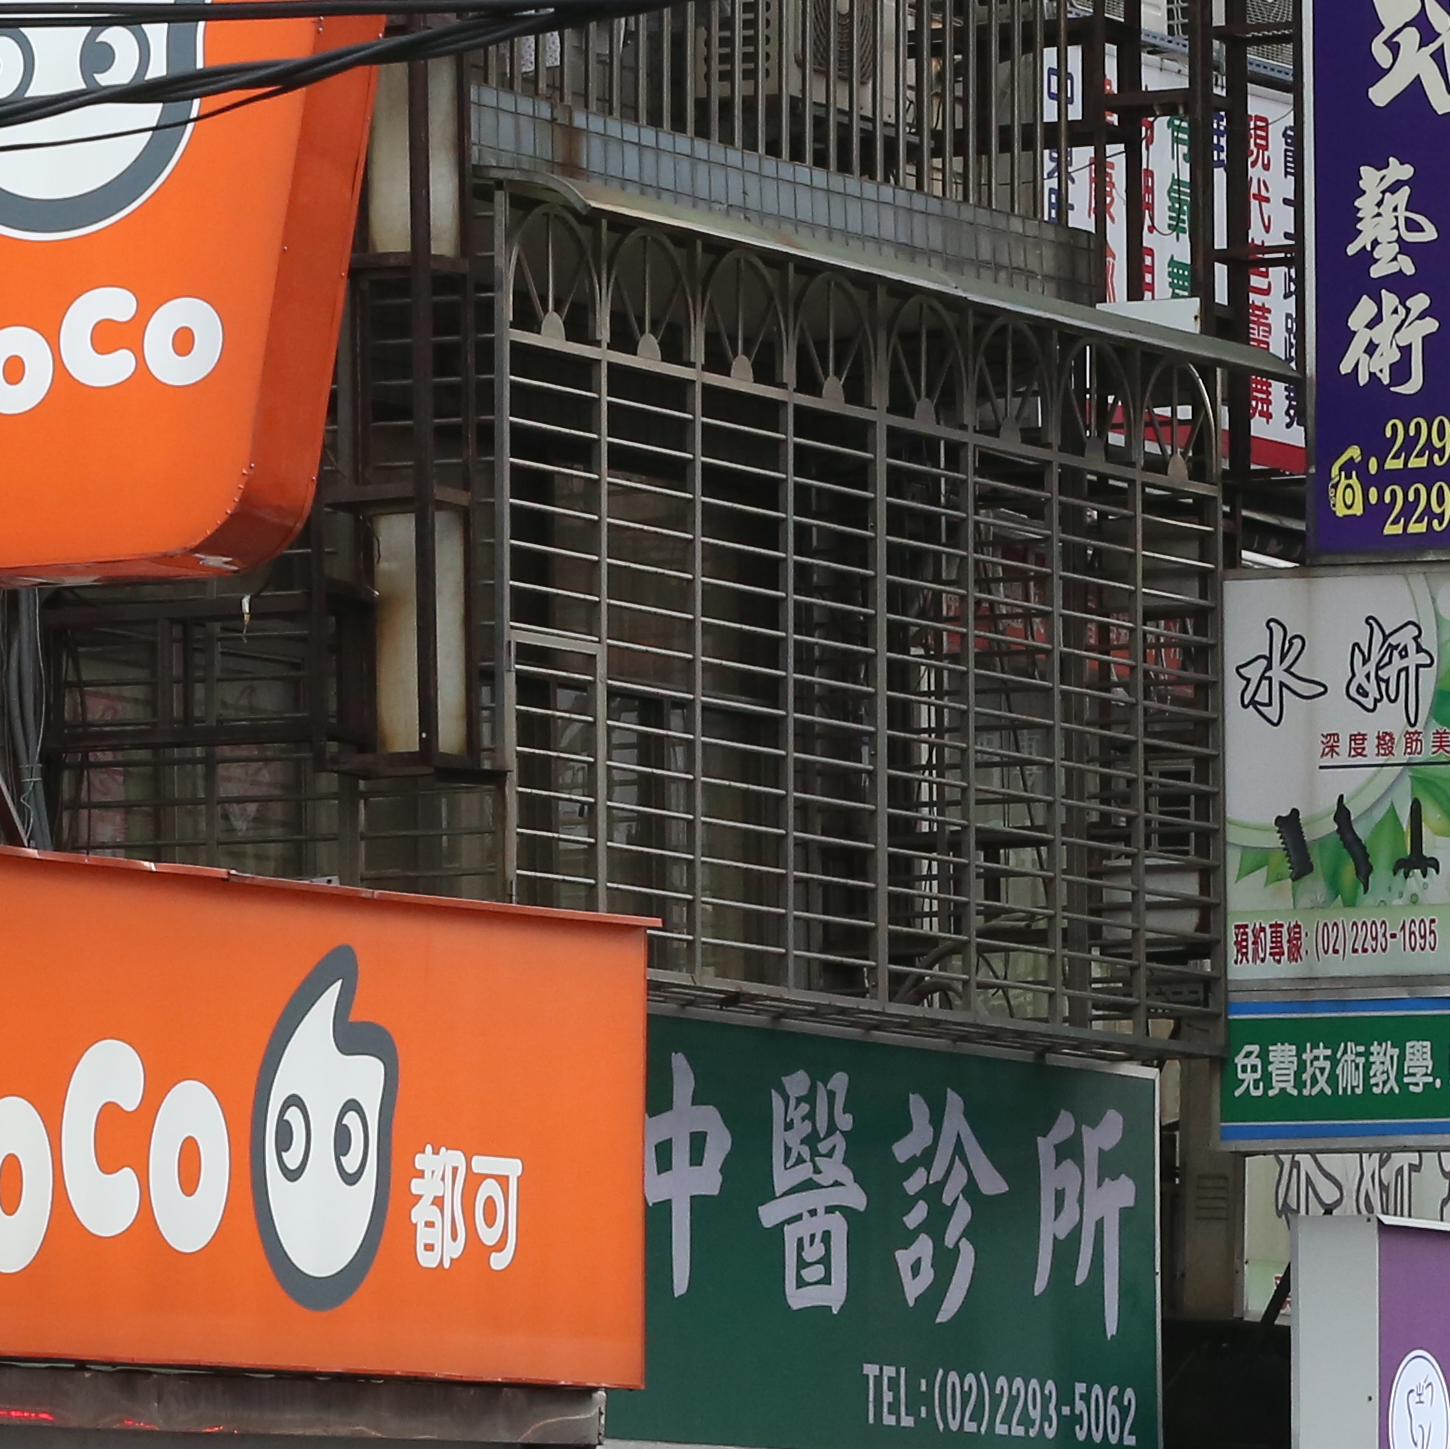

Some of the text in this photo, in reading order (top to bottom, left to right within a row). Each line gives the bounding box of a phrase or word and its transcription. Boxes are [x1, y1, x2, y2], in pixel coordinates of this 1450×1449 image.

[1340, 156, 1440, 396] 藝術
[410, 1142, 525, 1273] 都可
[644, 1051, 1137, 1341] 中醫診所
